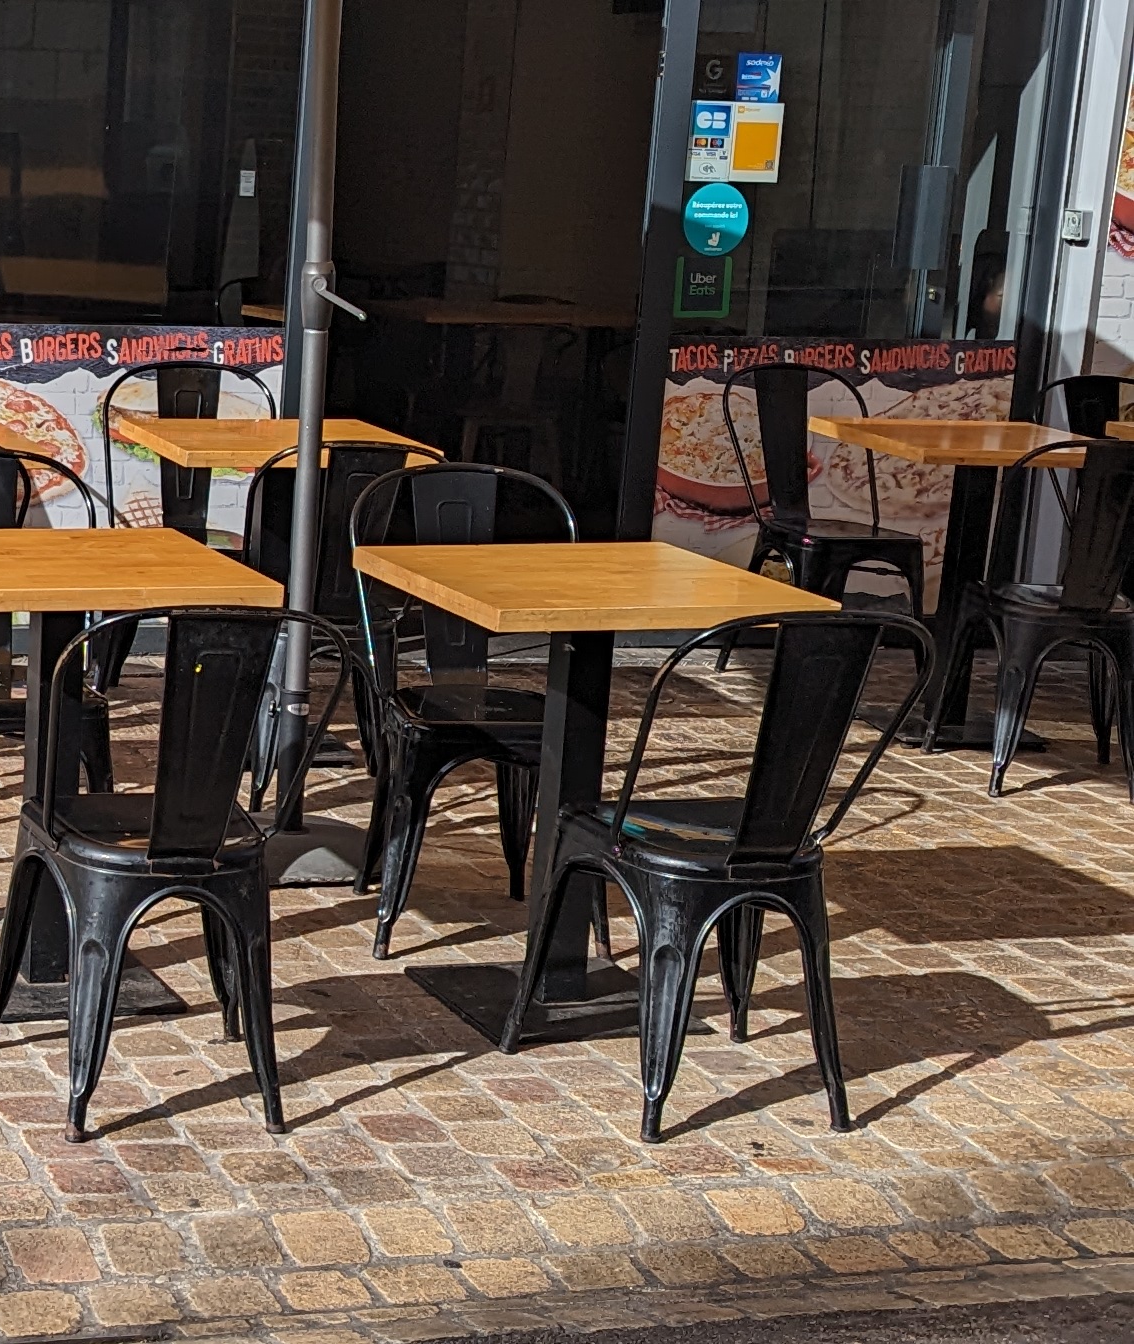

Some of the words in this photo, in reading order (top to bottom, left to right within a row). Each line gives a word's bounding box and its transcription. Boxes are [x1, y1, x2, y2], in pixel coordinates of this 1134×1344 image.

[690, 272, 717, 284] Uber
[689, 285, 716, 296] Eats
[20, 331, 103, 365] BURGERS
[213, 335, 284, 366] GRATINS
[669, 343, 719, 373] TACOS
[860, 342, 951, 375] SANDWICHS
[955, 346, 1016, 376] GRATINS
